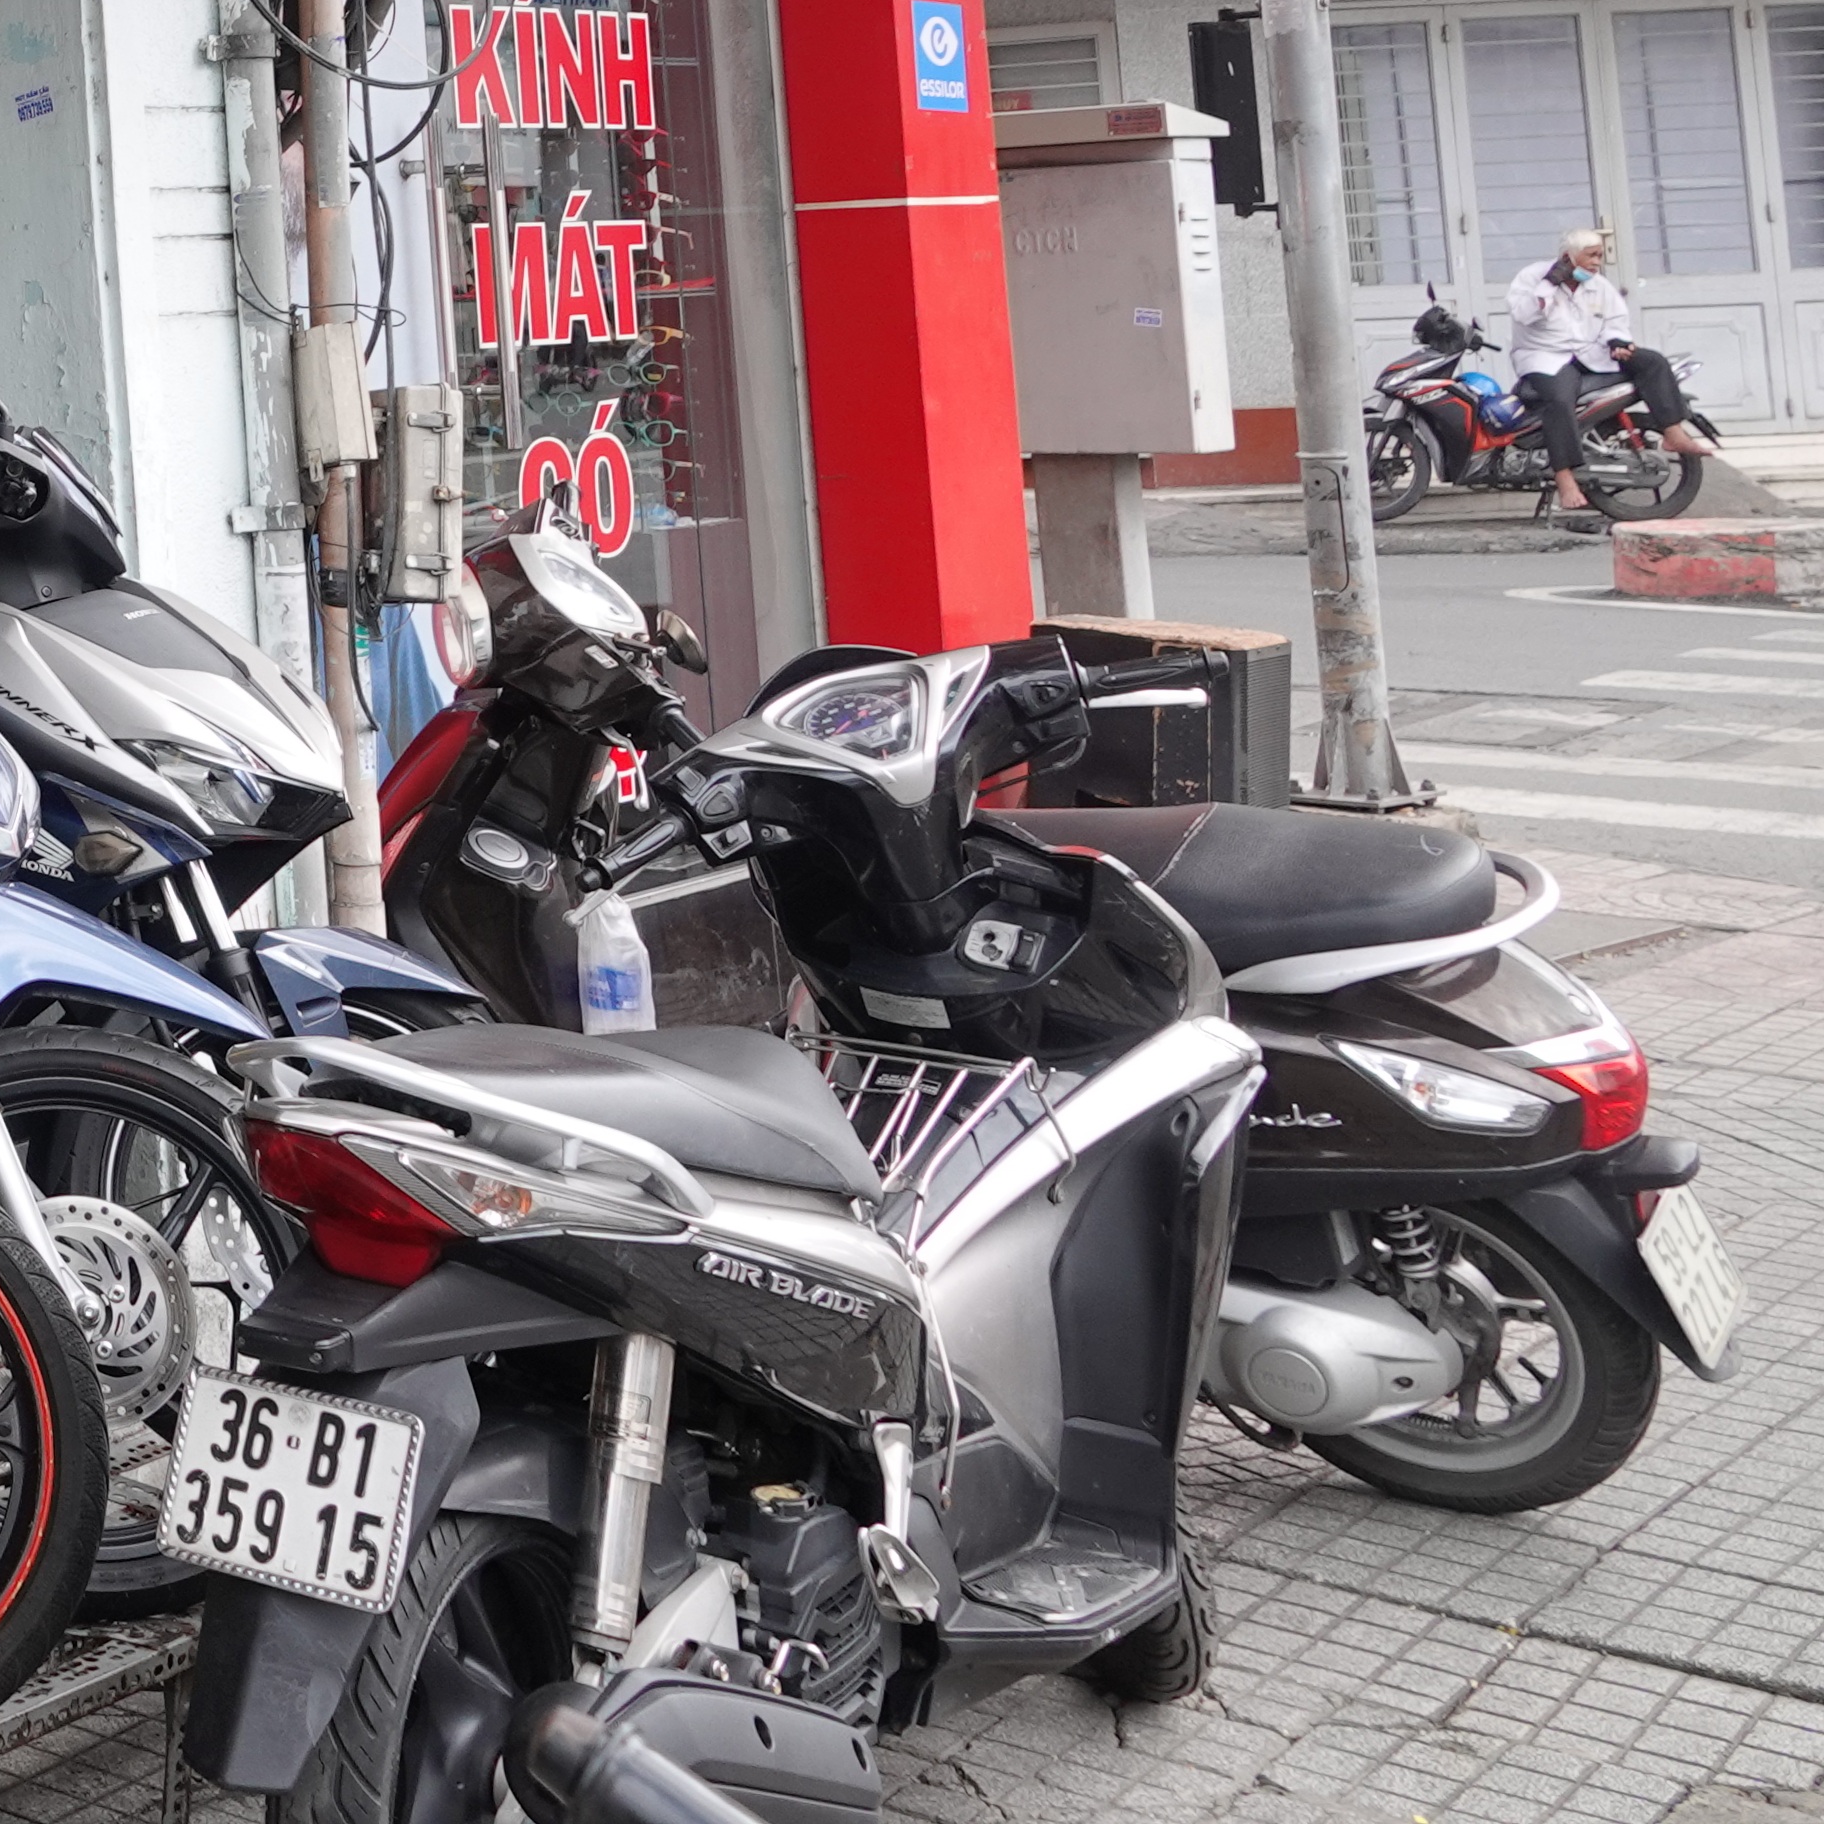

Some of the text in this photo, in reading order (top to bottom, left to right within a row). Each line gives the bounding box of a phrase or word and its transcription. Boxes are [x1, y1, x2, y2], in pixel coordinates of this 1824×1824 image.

[470, 189, 649, 349] MÁT
[695, 1250, 878, 1321] AIR BLADE
